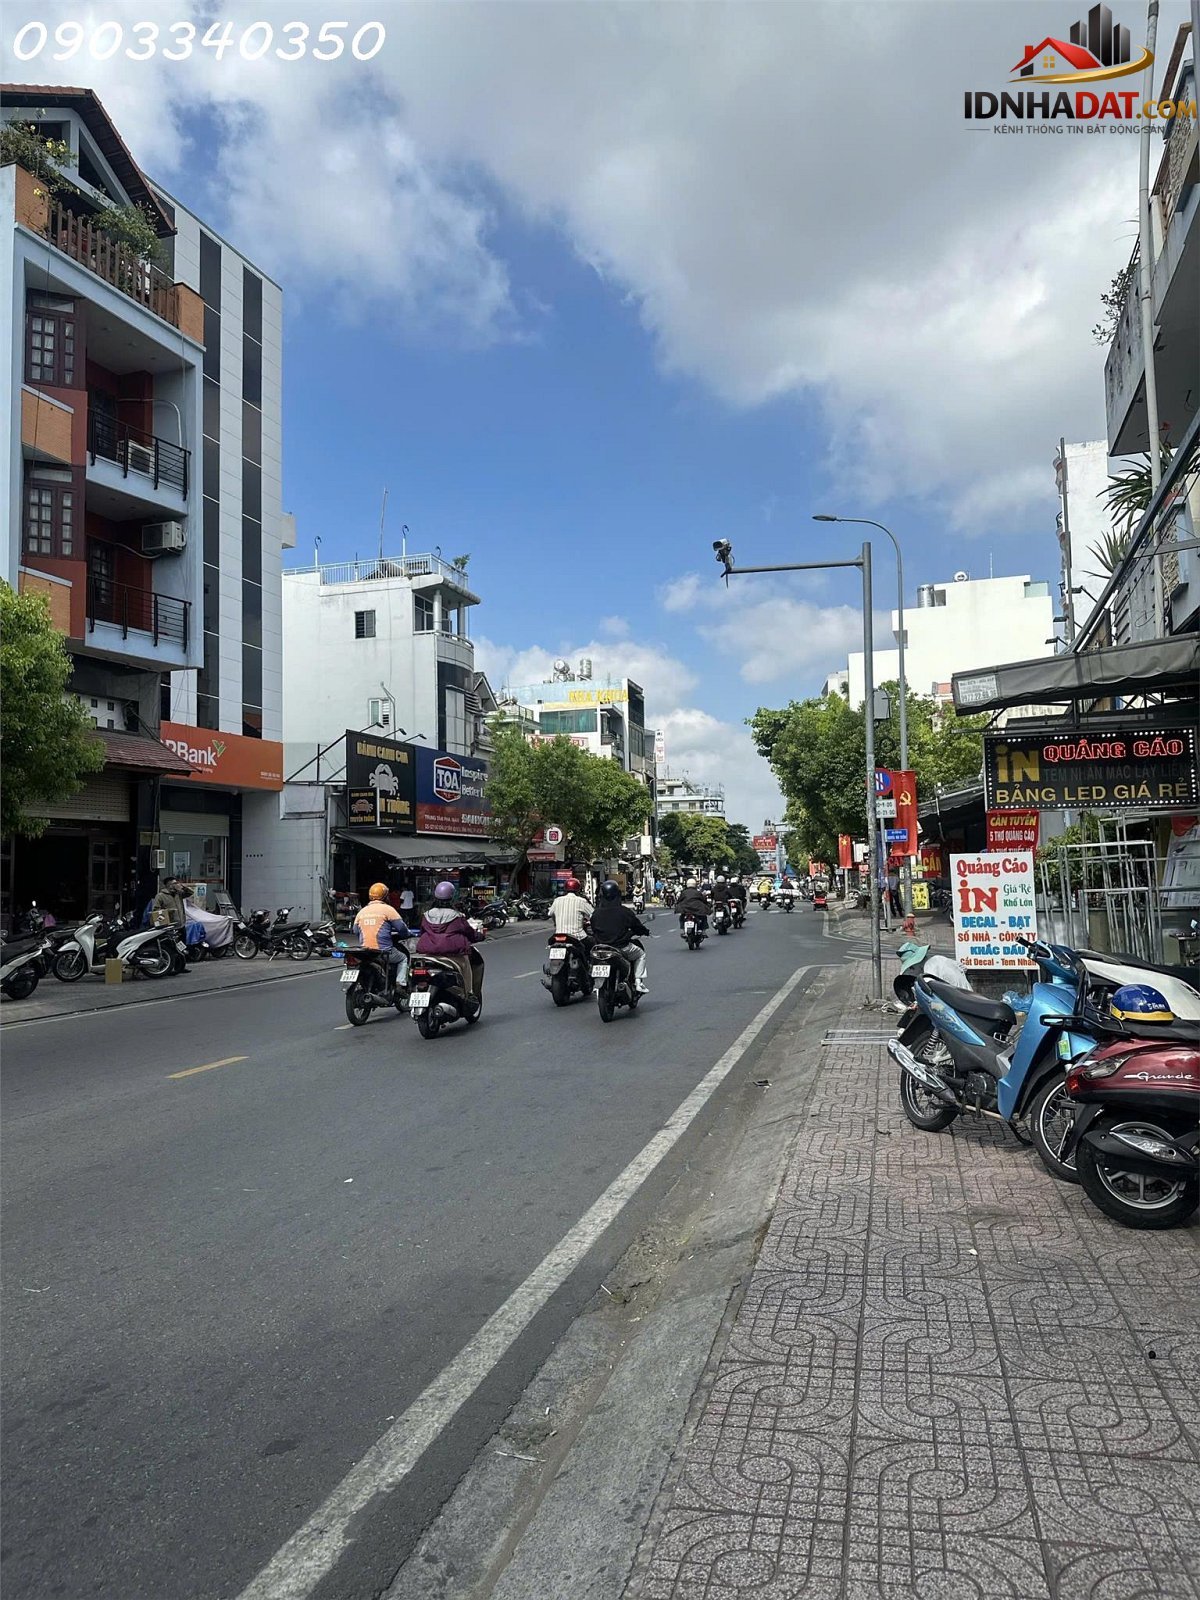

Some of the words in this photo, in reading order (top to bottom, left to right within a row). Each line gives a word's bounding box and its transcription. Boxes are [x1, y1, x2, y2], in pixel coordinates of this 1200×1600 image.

[1043, 739, 1126, 763] QUẢNG
[437, 768, 459, 790] TOA
[461, 766, 488, 782] Inspire
[1044, 767, 1067, 782] TEM
[996, 784, 1056, 804] BẢNG
[1064, 786, 1106, 801] LED
[1113, 780, 1151, 799] GIÁ
[1158, 777, 1189, 797] RẺ
[989, 831, 994, 842] 5
[994, 830, 1005, 843] THỢ
[1005, 828, 1023, 842] QUẢNG
[1024, 828, 1035, 842] CÁO
[956, 857, 1000, 877] Quảng
[1002, 857, 1028, 873] Cáo
[1003, 884, 1018, 896] Giá
[961, 916, 998, 928] DECAL
[1008, 915, 1031, 930] BẠT
[957, 930, 970, 942] SỐ
[972, 931, 991, 942] NHÀ
[1026, 932, 1036, 942] TY
[970, 943, 1000, 955] KHẮC
[973, 958, 994, 966] Decal
[1001, 958, 1016, 966] Tem
[1124, 1071, 1194, 1081] Grande
